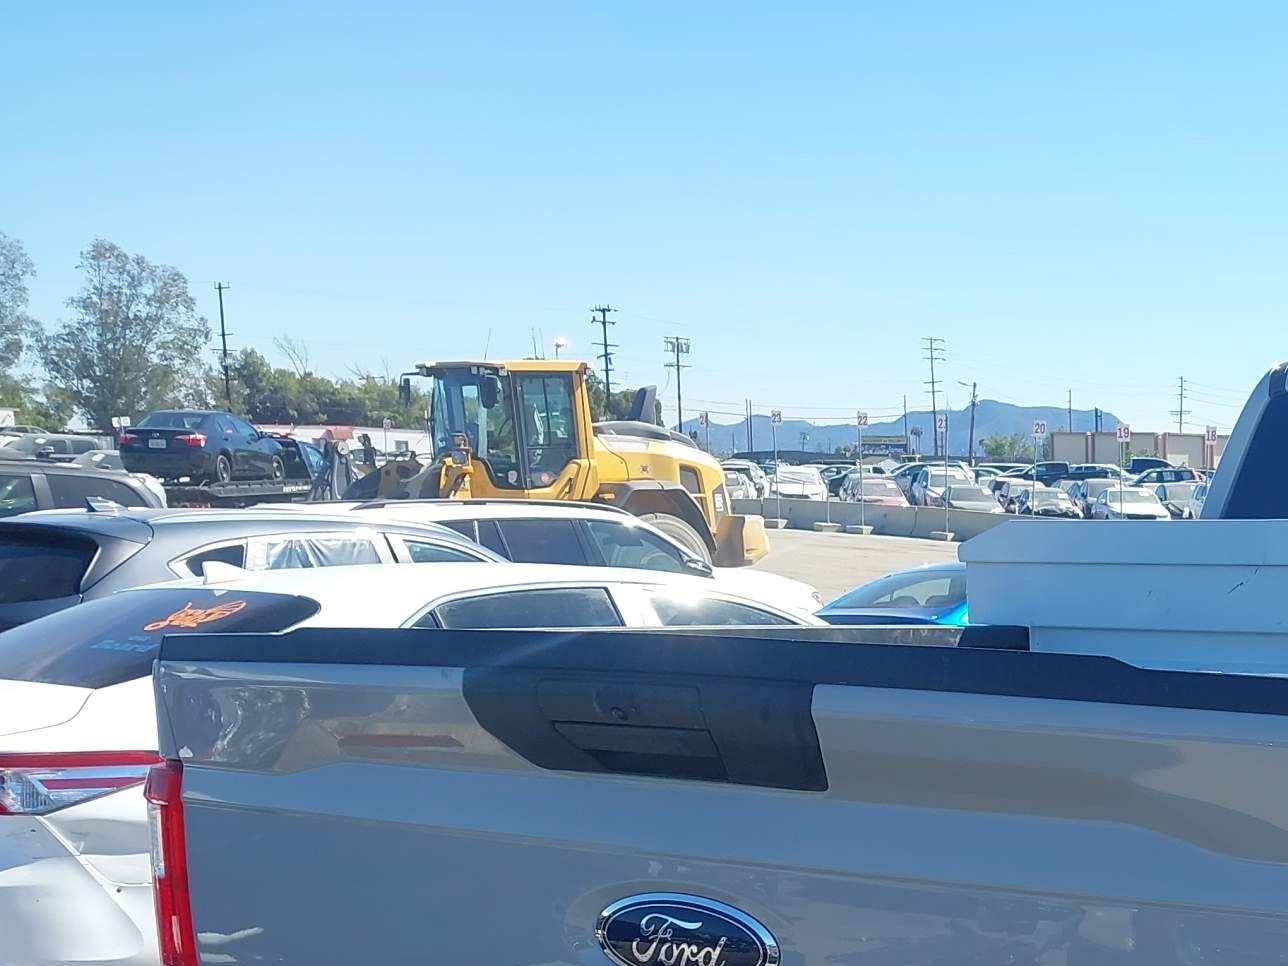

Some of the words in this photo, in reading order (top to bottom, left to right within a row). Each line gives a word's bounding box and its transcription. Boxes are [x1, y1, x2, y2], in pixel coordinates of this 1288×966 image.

[772, 414, 782, 424] 23
[857, 416, 868, 426] 22
[1034, 423, 1046, 434] 20
[1117, 427, 1129, 438] 19
[1206, 430, 1216, 441] 18
